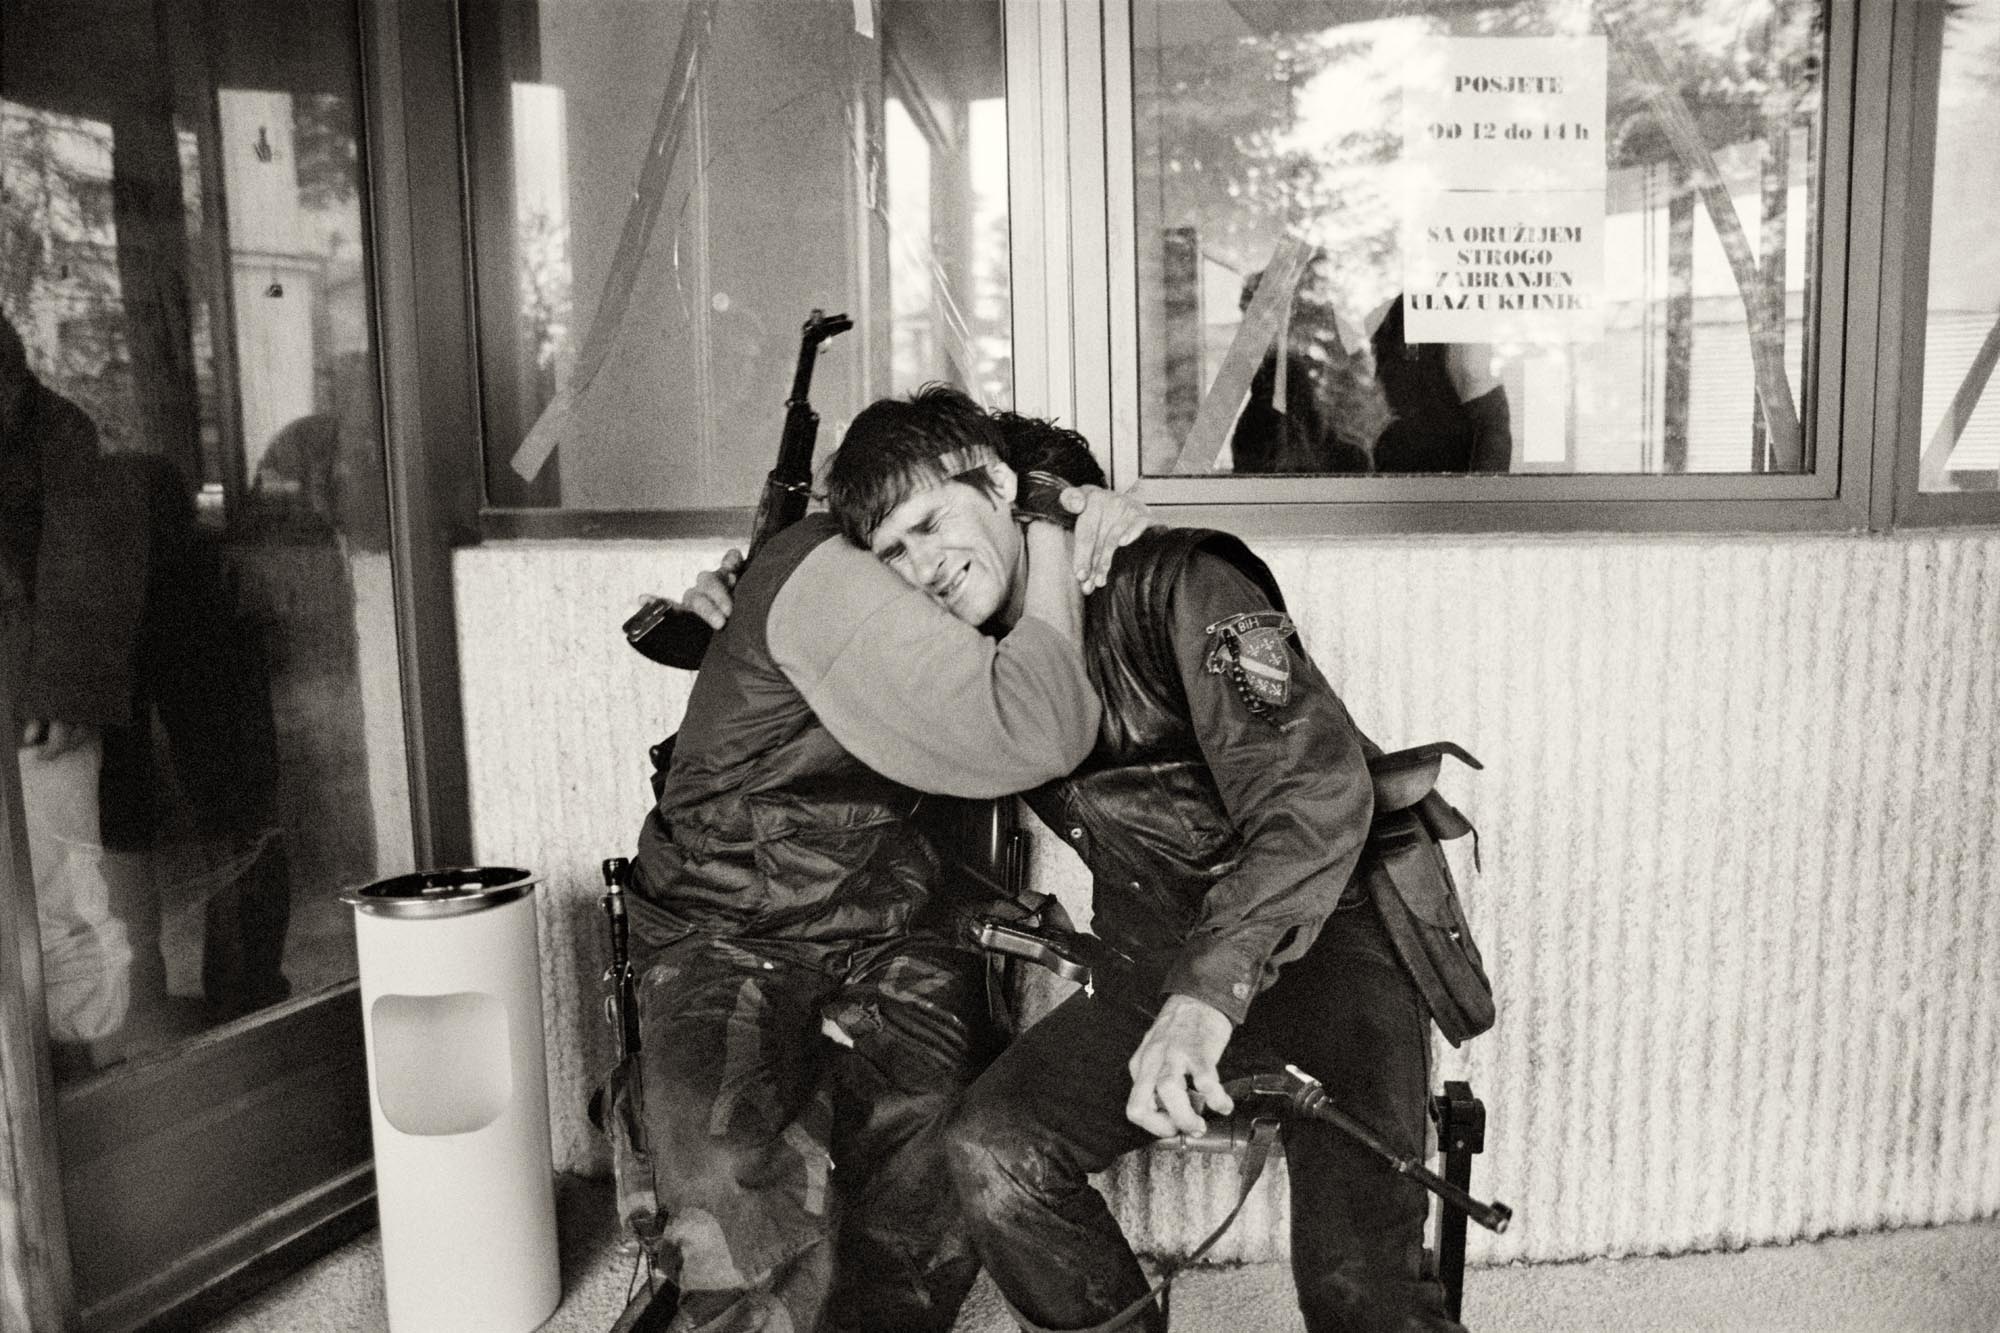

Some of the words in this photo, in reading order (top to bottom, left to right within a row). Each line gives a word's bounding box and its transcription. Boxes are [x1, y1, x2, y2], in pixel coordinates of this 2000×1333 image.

[1455, 76, 1564, 94] POSJETE
[1473, 122, 1497, 140] 12
[1504, 123, 1533, 140] do
[1575, 123, 1589, 140] h
[1427, 226, 1455, 243] SA
[1457, 249, 1553, 265] STROGO
[1436, 271, 1574, 288] ZABRANJEN
[1411, 294, 1470, 310] ULAZ
[1477, 294, 1492, 310] U
